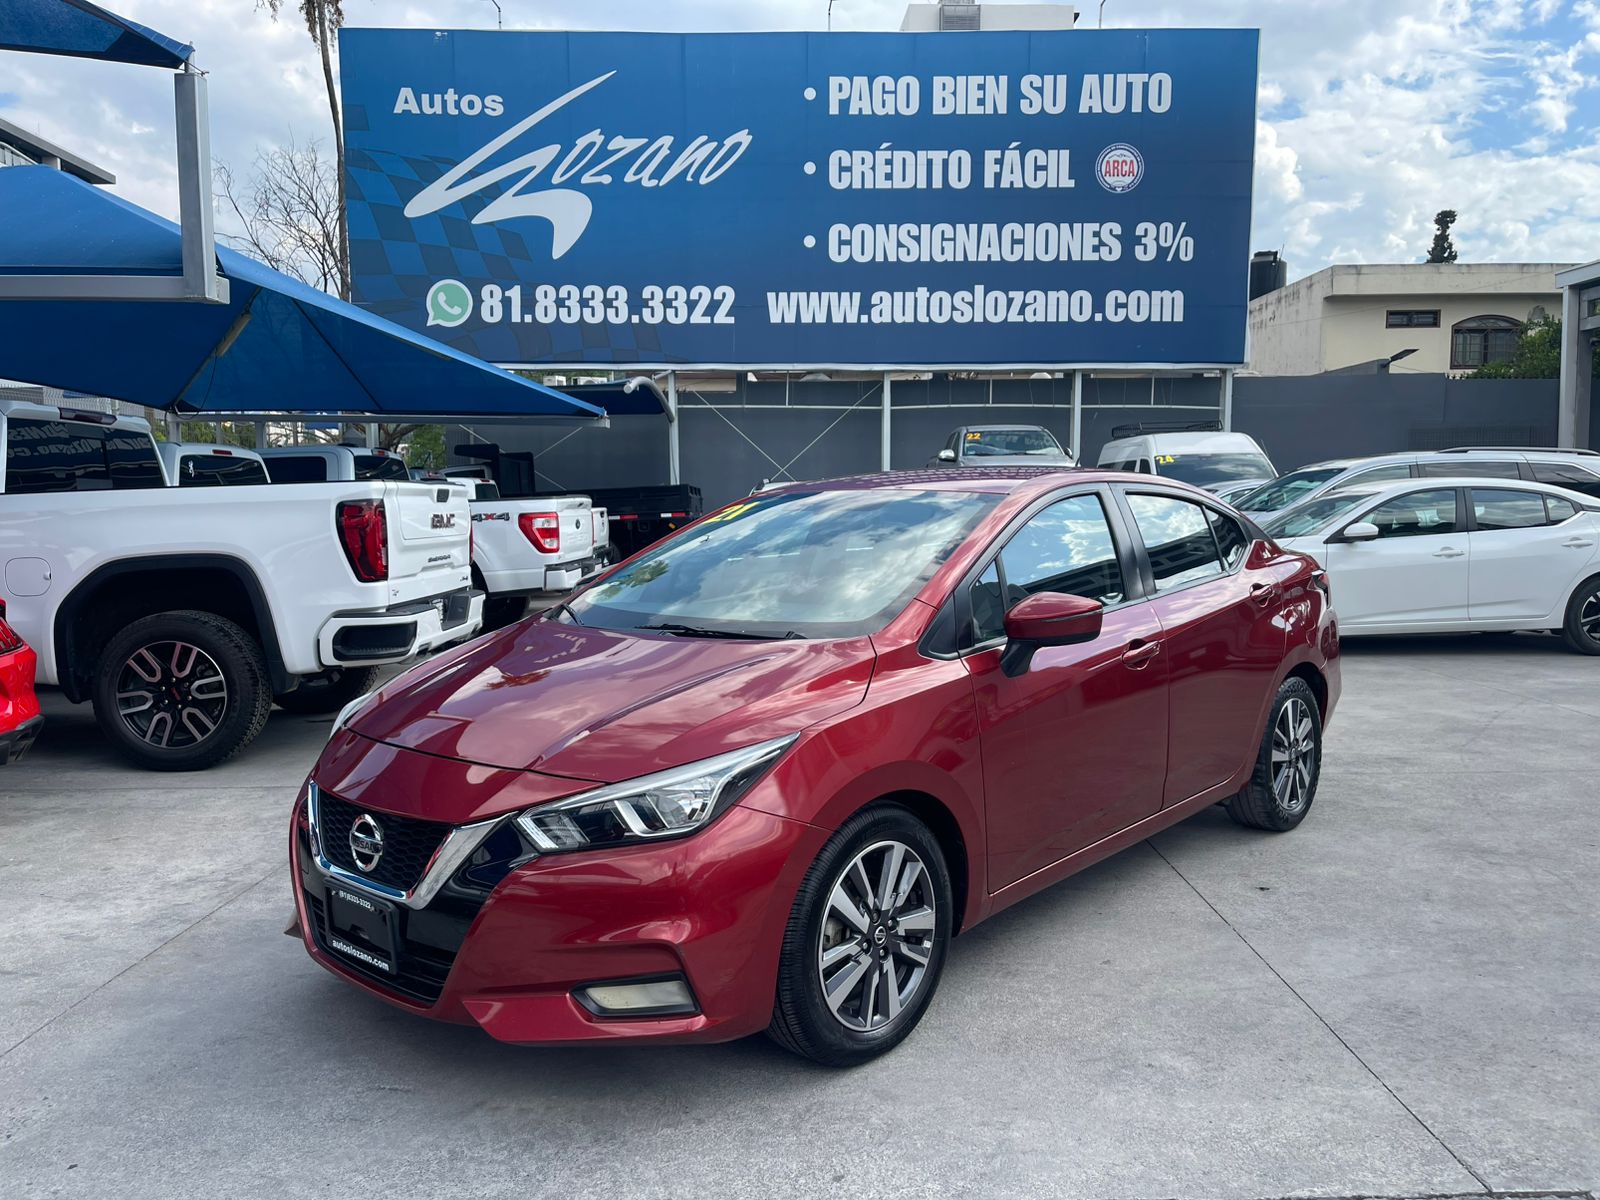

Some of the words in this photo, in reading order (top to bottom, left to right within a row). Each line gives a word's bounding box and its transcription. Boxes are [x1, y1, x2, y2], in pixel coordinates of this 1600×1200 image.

[393, 86, 505, 116] Autos
[828, 75, 920, 116] PAGO
[932, 75, 1008, 115] BIEN
[1020, 73, 1067, 114] SU
[1078, 72, 1173, 114] AUTO
[403, 69, 754, 260] Lozano
[828, 142, 972, 190] CRÉDITO
[984, 141, 1076, 189] FÁCIL
[1104, 159, 1135, 178] ARCA
[828, 222, 1122, 263] CONSIGNACIONES
[1134, 221, 1195, 263] 3%
[480, 283, 736, 325] 81.8333.3322
[766, 284, 1185, 324] www.autoslozano.com
[966, 432, 981, 441] 22
[332, 939, 389, 971] autoslozano.com
